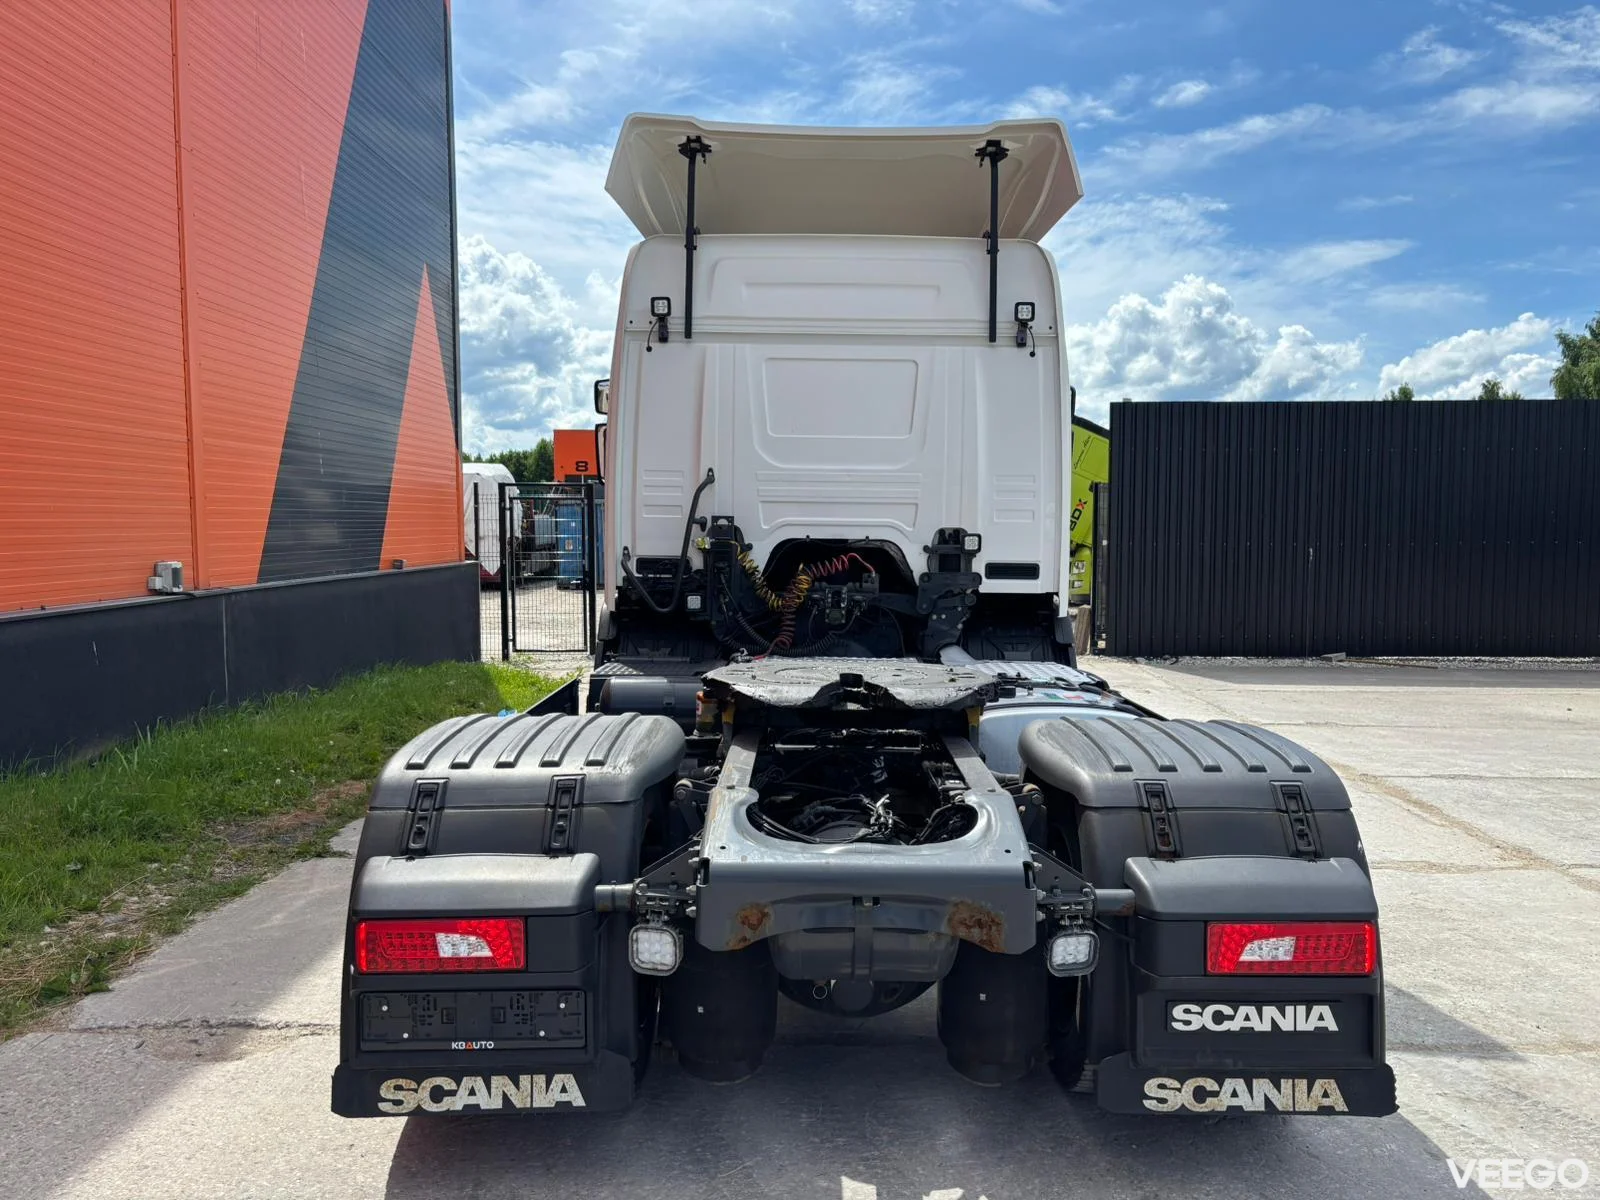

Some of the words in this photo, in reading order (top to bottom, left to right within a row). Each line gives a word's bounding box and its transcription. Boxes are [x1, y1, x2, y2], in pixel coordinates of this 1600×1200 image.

[575, 460, 589, 472] 8
[1171, 1004, 1339, 1032] SCANIA
[377, 1073, 586, 1114] SCANIA
[1142, 1076, 1349, 1113] SCANIA
